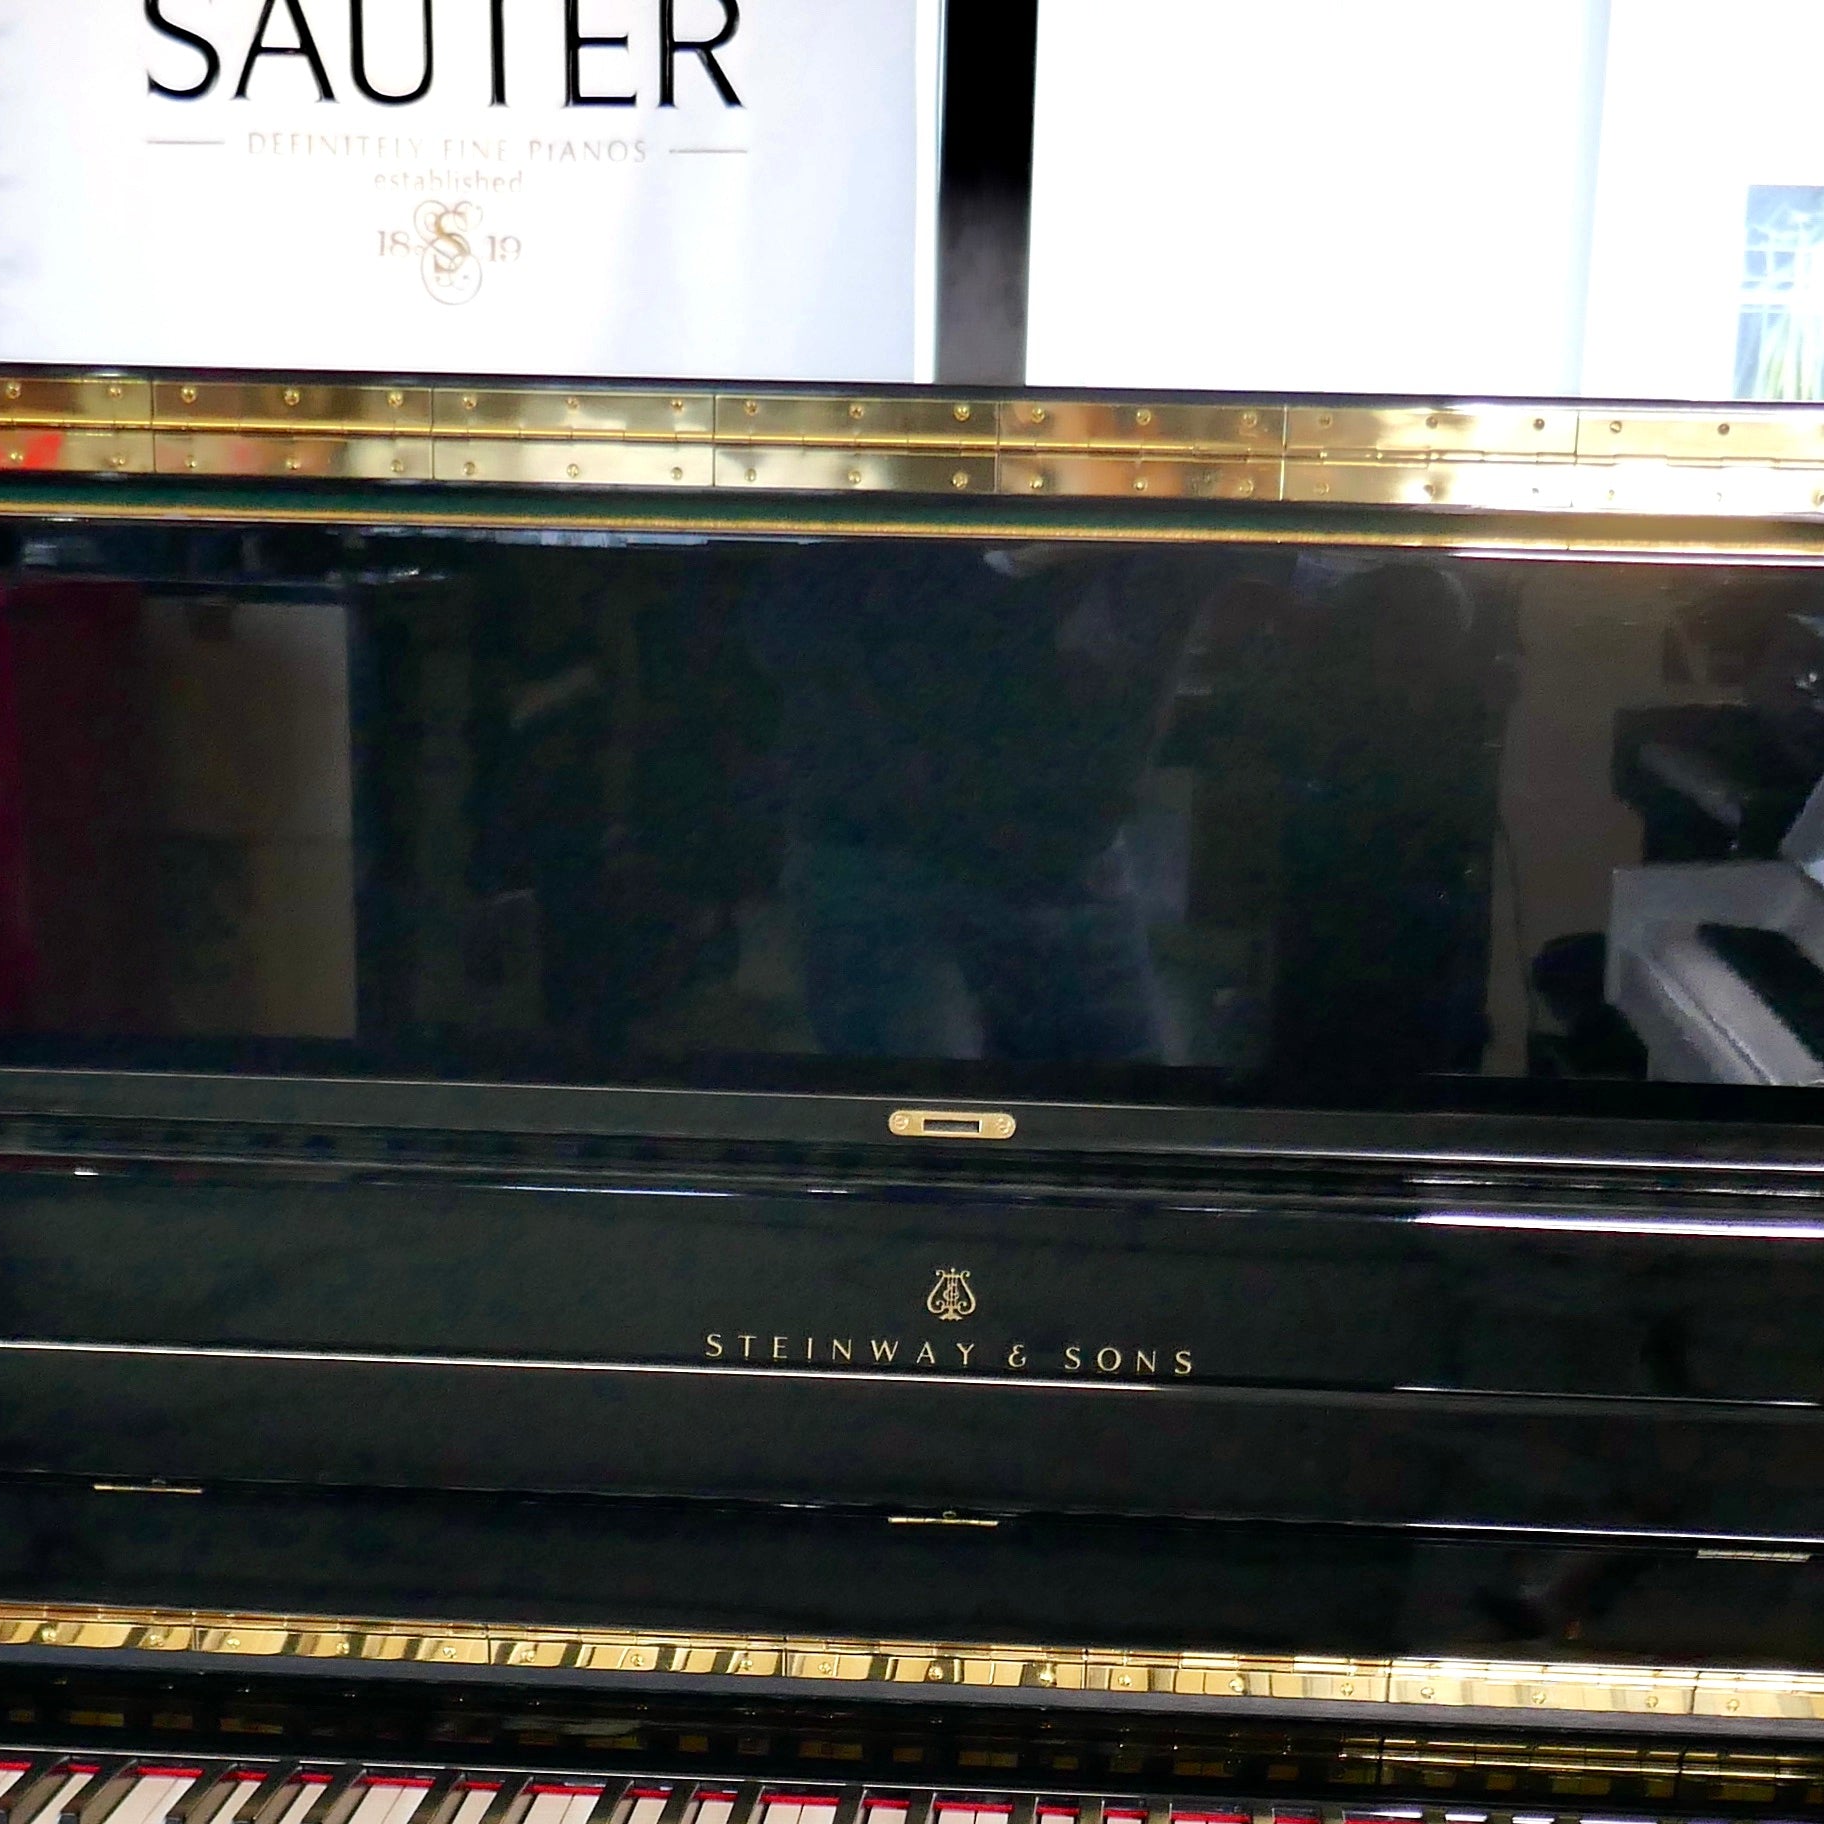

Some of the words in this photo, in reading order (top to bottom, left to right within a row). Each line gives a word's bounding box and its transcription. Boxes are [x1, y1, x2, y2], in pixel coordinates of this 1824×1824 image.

[143, 0, 744, 108] SAUTER
[248, 131, 423, 158] DEFINITELY
[443, 138, 507, 162] FINE
[528, 139, 647, 163] PIANOS
[374, 168, 523, 193] established
[377, 230, 410, 257] 18
[486, 235, 522, 262] 19
[705, 1332, 977, 1366] STEINWAY
[1007, 1343, 1028, 1369] &
[1064, 1345, 1193, 1375] SONS
